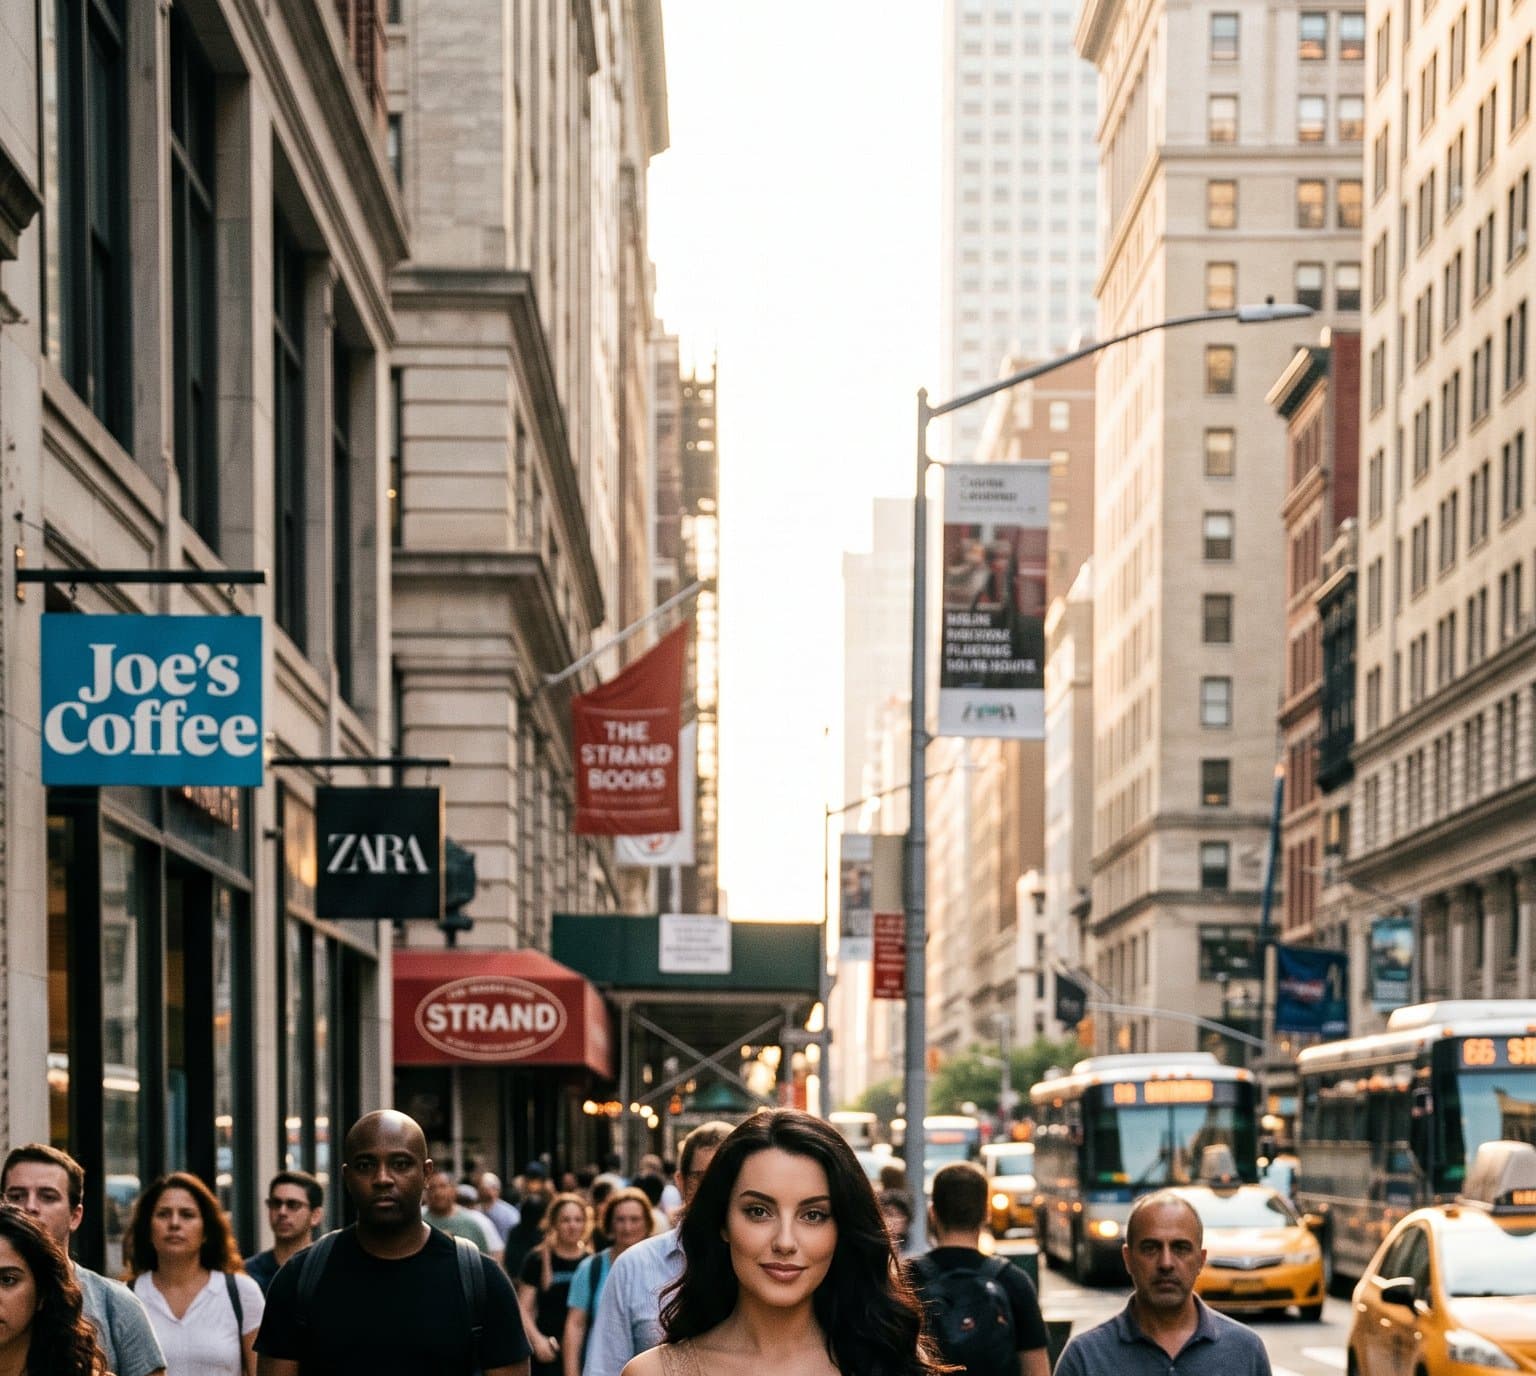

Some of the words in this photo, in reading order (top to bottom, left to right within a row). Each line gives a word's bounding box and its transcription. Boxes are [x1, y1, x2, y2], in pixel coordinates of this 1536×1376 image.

[78, 643, 240, 703] Joe's
[44, 699, 258, 757] Coffee
[604, 720, 648, 742] THE
[580, 743, 673, 766] STRAND
[588, 767, 666, 791] BOOKS
[327, 833, 430, 874] ZARA
[426, 1003, 558, 1032] STRAND
